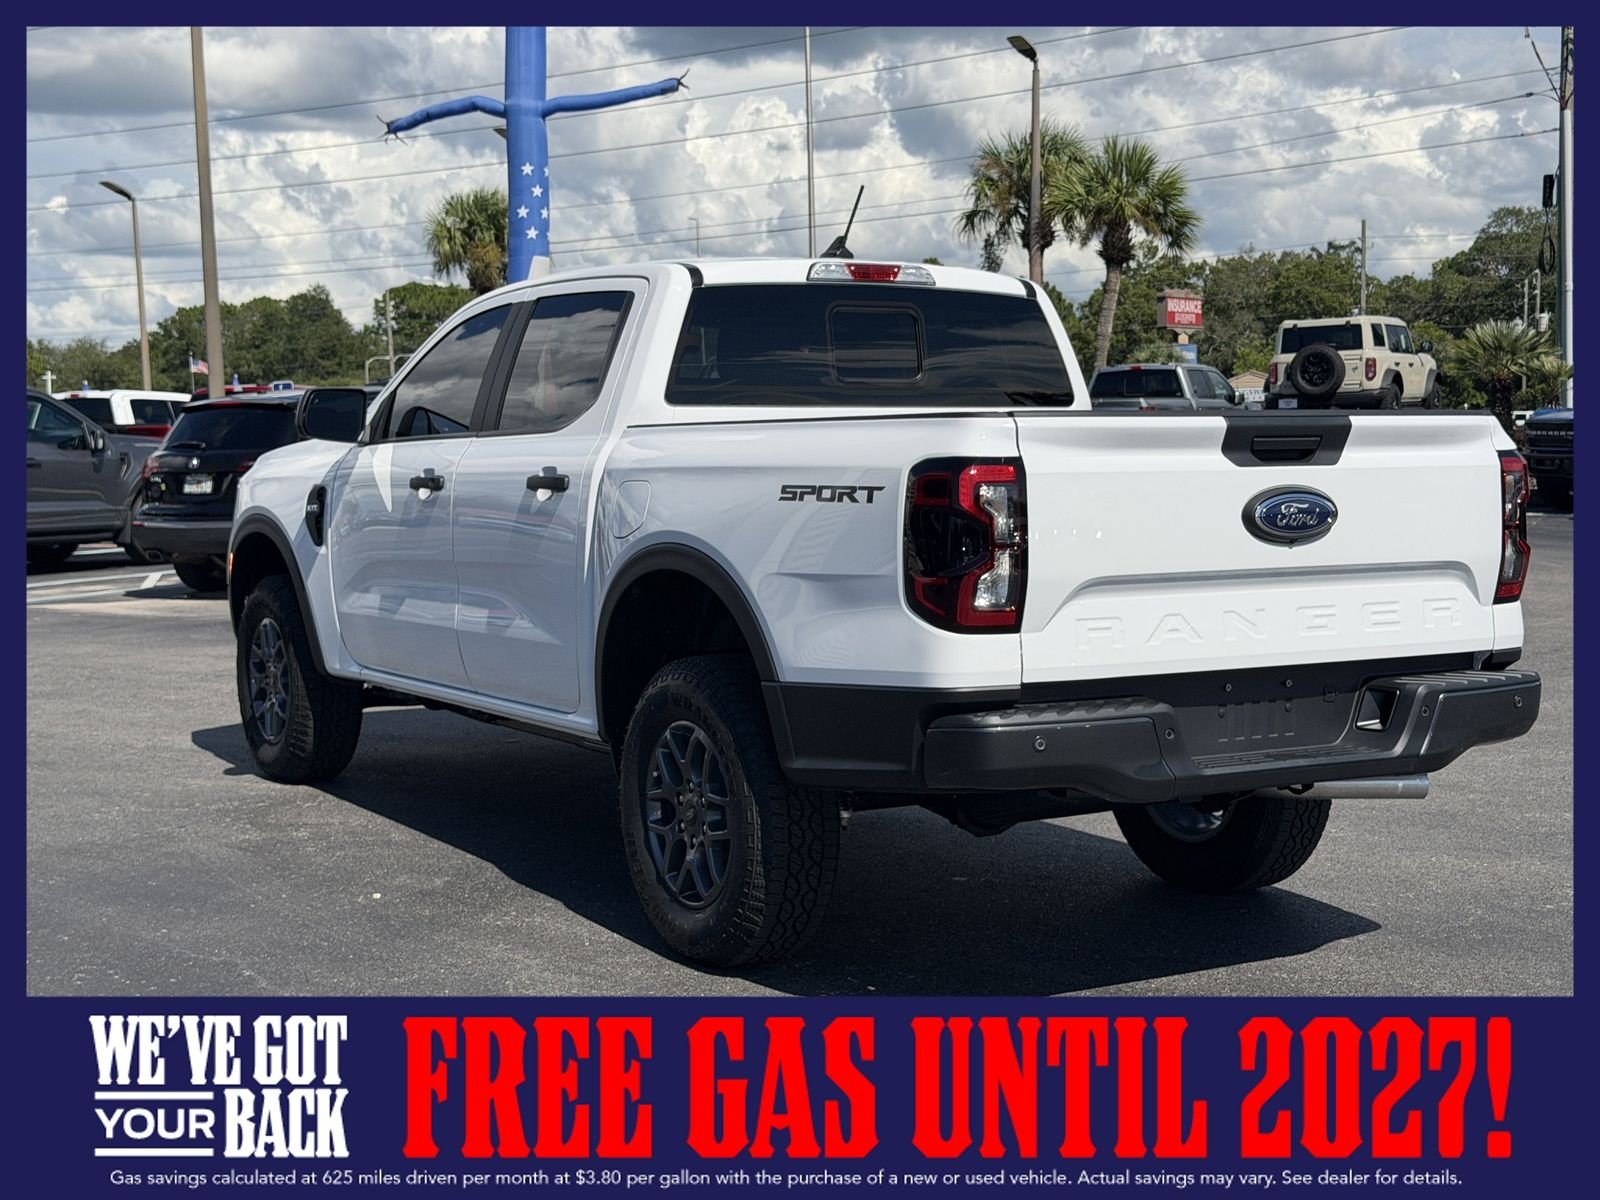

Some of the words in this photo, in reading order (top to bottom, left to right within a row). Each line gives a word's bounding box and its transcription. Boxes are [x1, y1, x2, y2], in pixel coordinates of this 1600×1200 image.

[778, 484, 886, 504] SPORT
[1276, 502, 1319, 527] Ford
[1074, 597, 1464, 651] RANGER
